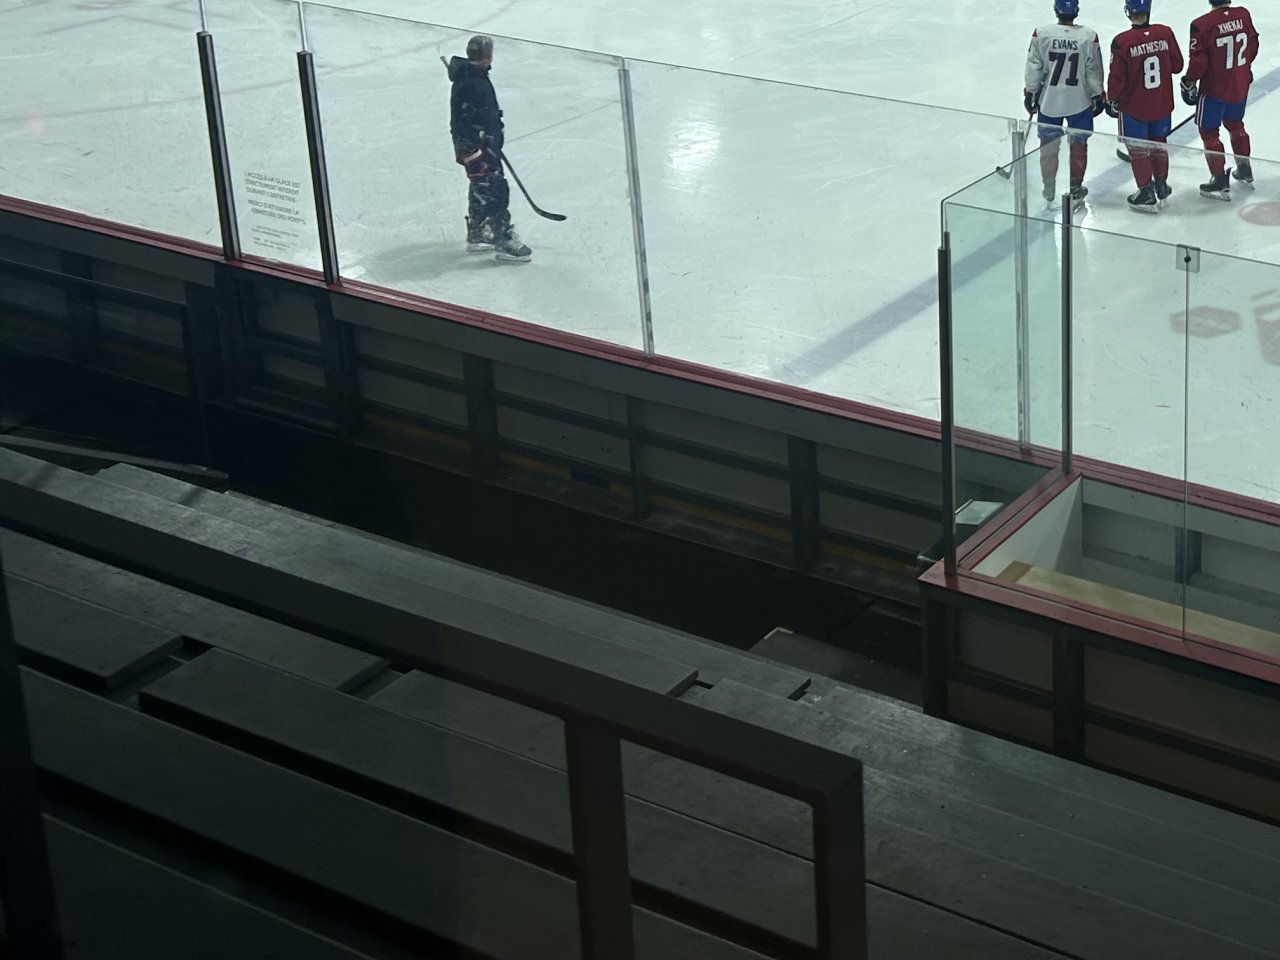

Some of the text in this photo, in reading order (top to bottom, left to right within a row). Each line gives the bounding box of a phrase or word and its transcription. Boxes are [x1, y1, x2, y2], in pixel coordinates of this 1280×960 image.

[1217, 19, 1244, 35] XHEKAJ
[1052, 39, 1078, 51] EVANS
[1129, 40, 1169, 58] MATHESON
[1216, 32, 1248, 70] 72
[1048, 51, 1080, 87] 71
[1143, 55, 1161, 90] 8
